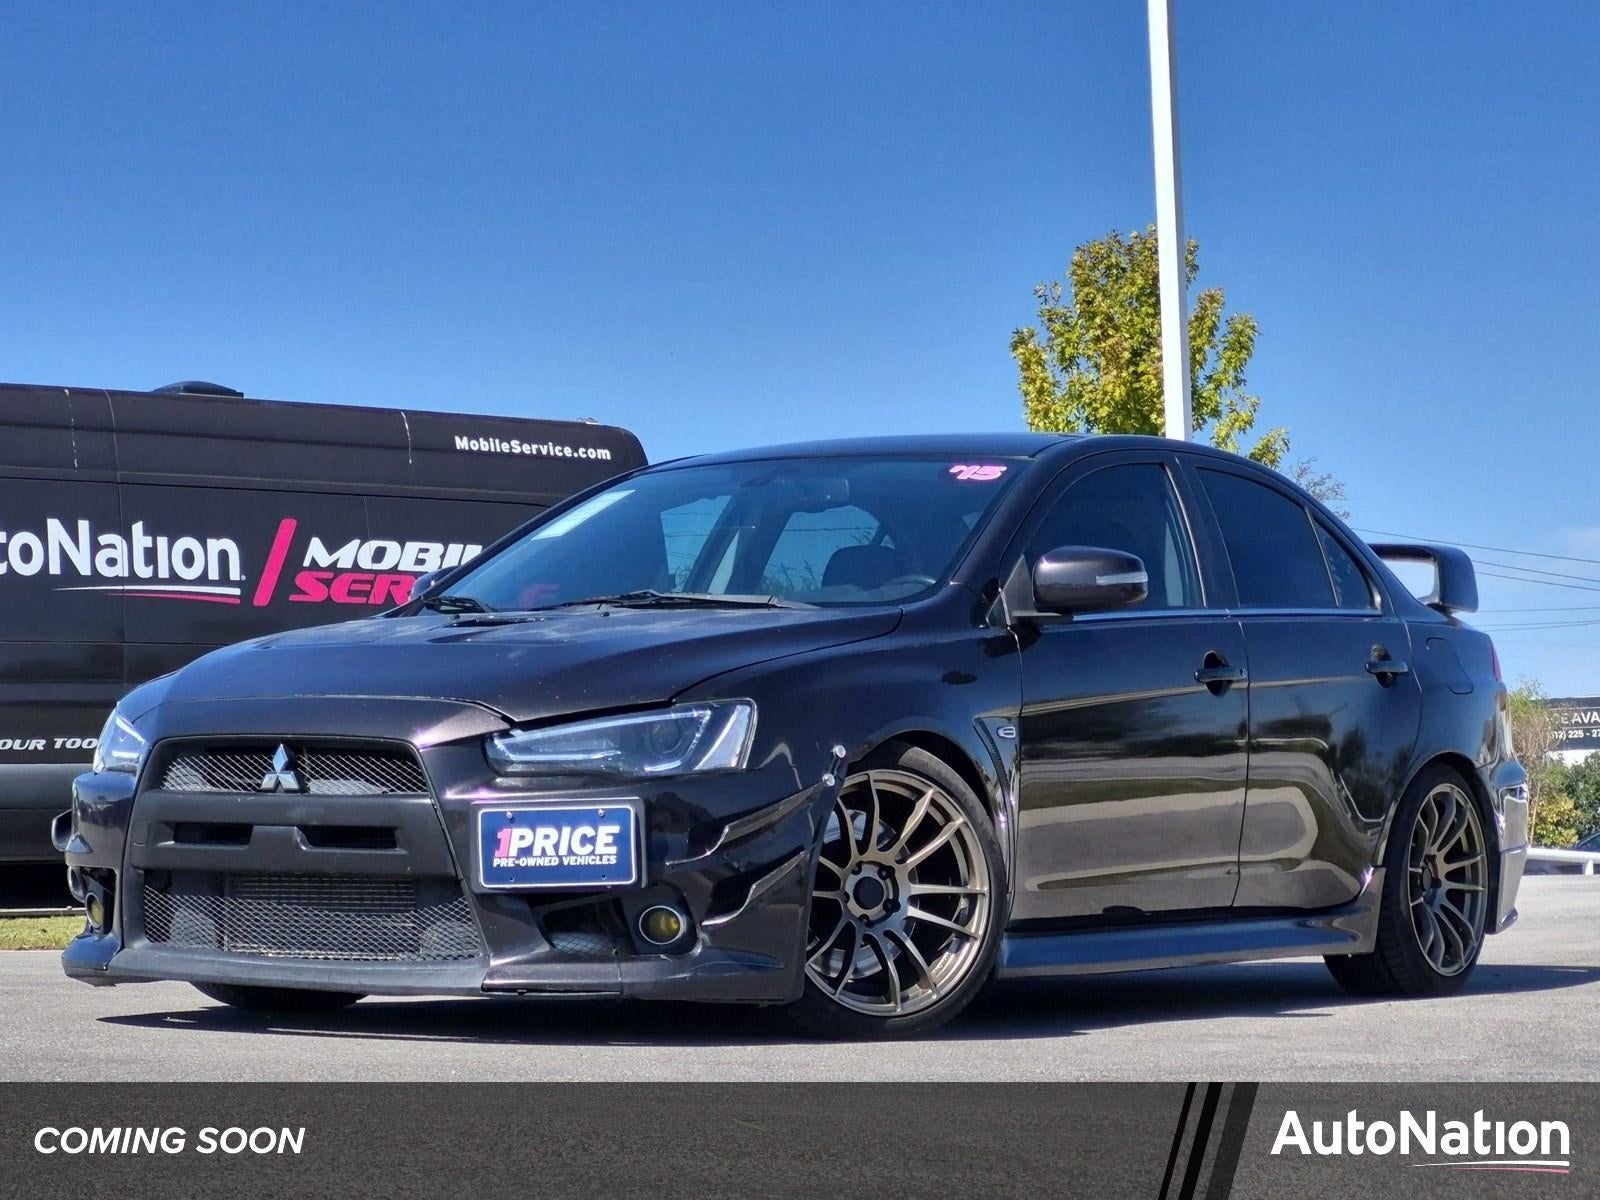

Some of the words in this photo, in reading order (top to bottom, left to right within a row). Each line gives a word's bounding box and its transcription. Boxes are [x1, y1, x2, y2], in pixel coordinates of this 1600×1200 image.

[454, 435, 612, 460] MobileService.com
[494, 825, 621, 858] 1PRICE
[492, 855, 560, 868] PRE-OWNED
[562, 854, 618, 866] VEHICLES
